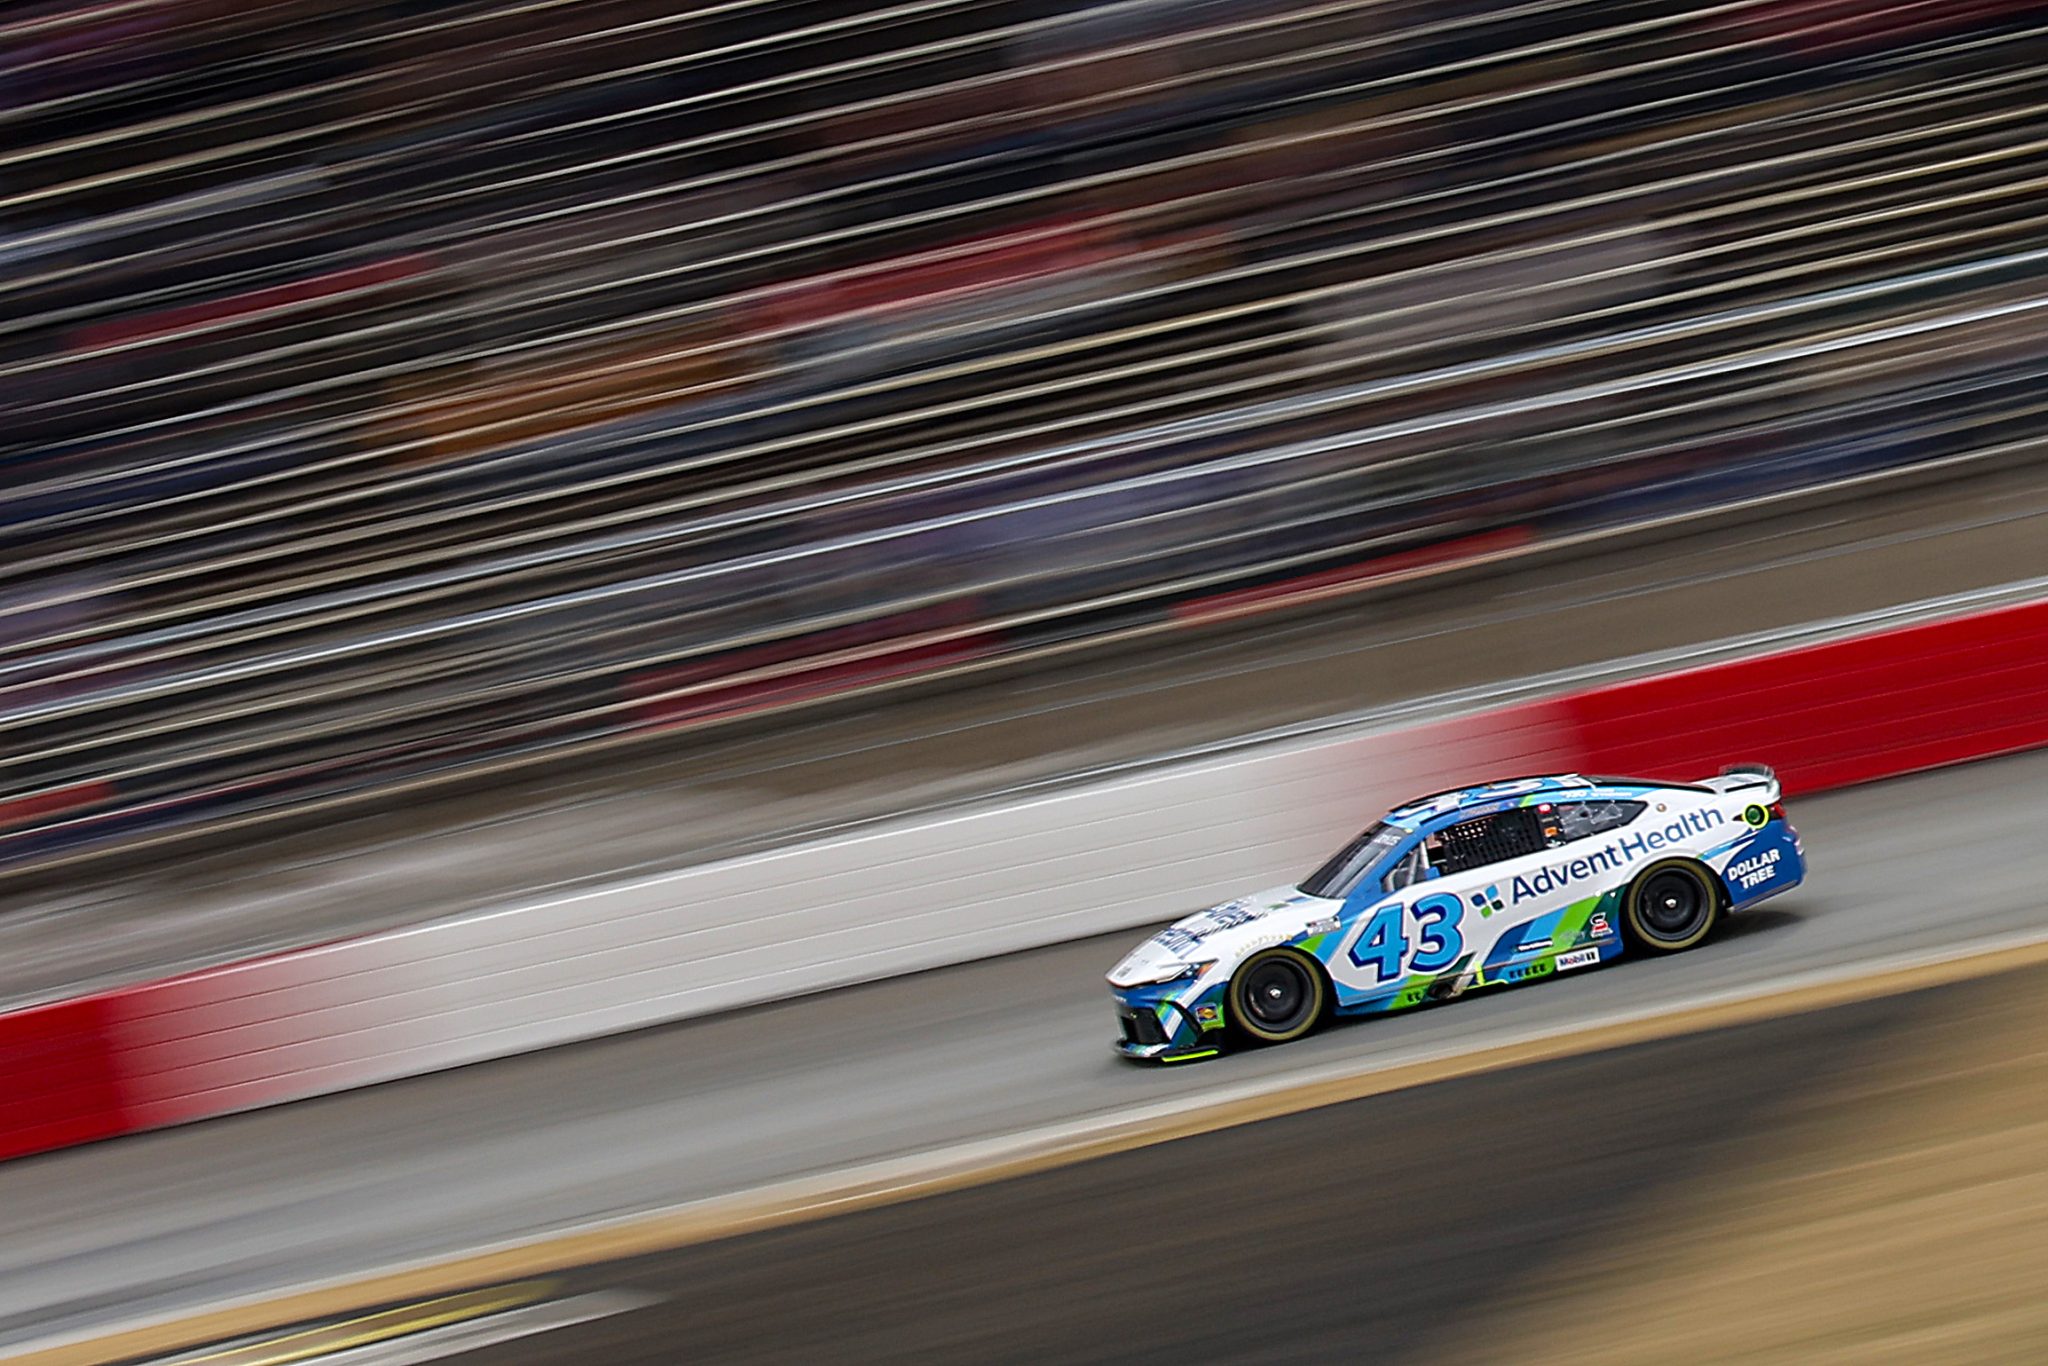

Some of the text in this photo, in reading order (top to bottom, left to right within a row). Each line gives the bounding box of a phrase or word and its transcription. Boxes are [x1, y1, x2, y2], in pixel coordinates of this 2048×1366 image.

[1512, 808, 1725, 904] AdventHealth
[1727, 848, 1781, 881] DOLLAR
[1740, 865, 1777, 889] TREE
[1348, 892, 1464, 983] 43
[1559, 953, 1585, 967] Mobil
